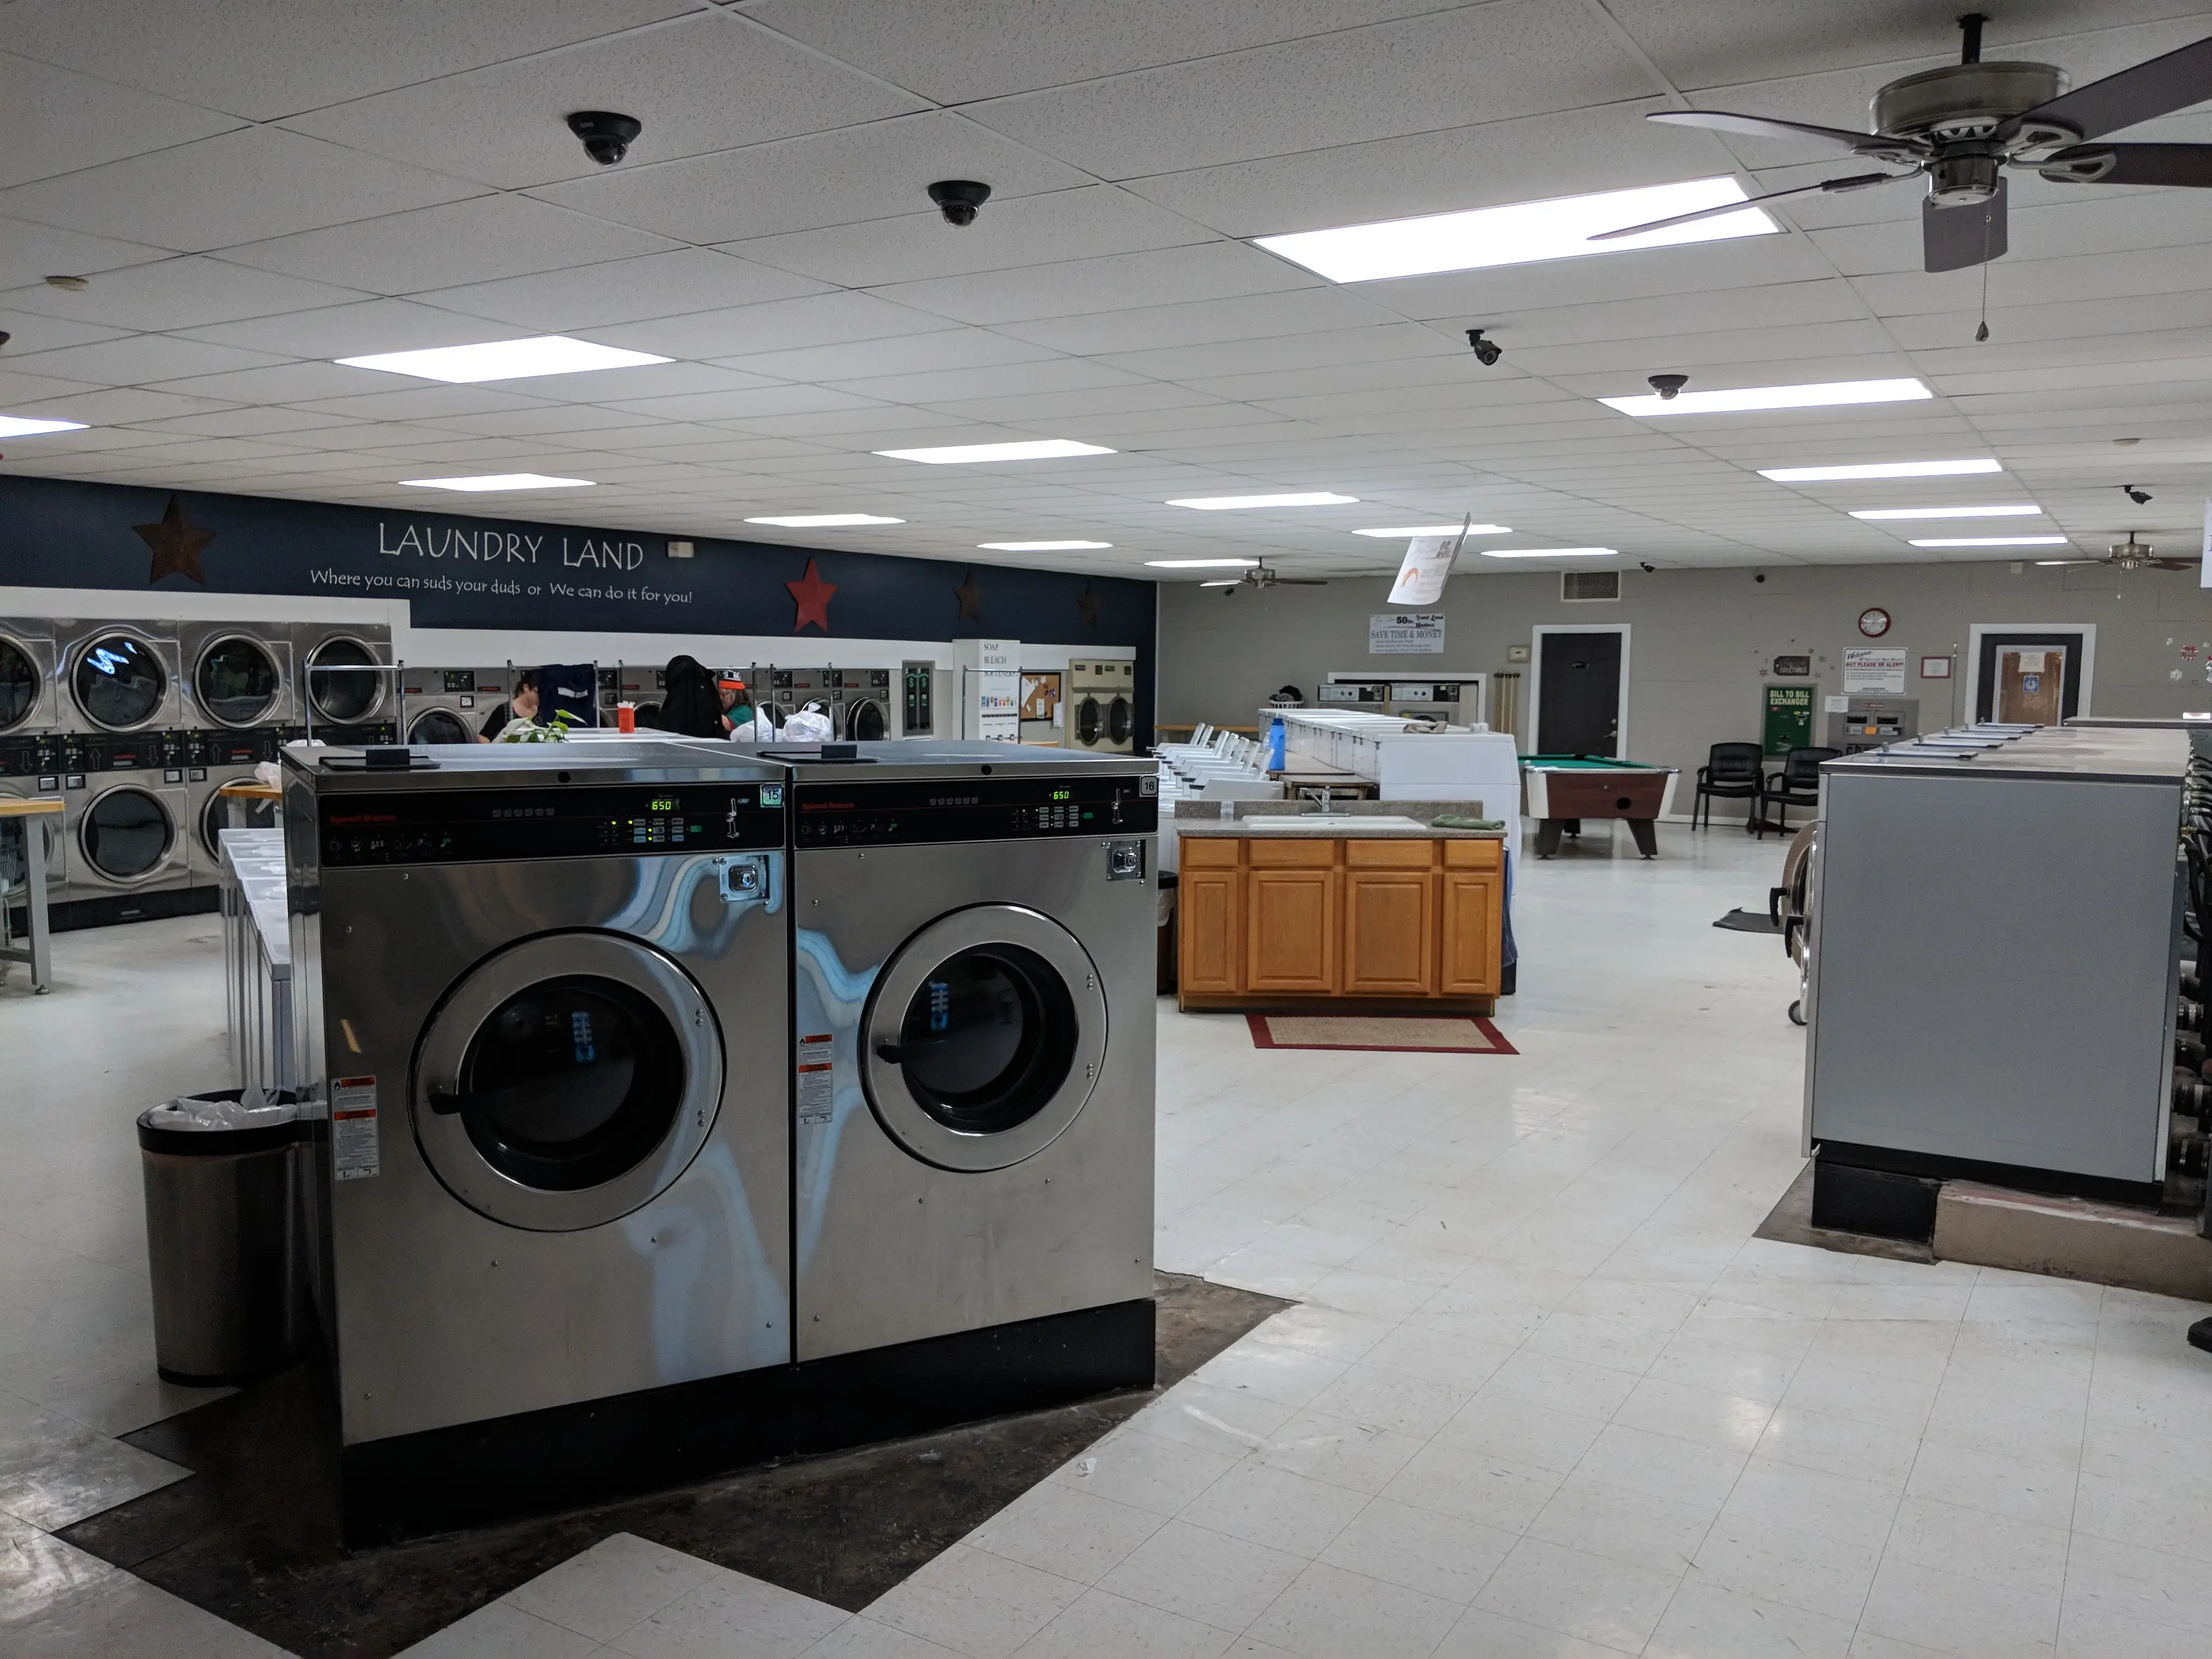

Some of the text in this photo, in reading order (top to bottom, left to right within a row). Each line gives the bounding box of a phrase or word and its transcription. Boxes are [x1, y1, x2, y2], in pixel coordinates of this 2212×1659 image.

[379, 522, 644, 571] LAUNDRY LAND
[311, 568, 692, 606] Where you can suds your duds or We can do it for you!
[1371, 630, 1389, 639] SAVE
[1390, 630, 1407, 639] TIME
[1416, 630, 1442, 639] MONEY
[984, 656, 1007, 664] BLEACH
[1144, 781, 1154, 791] 16
[768, 791, 778, 800] 15
[1053, 791, 1069, 800] 650
[652, 801, 672, 810] 650
